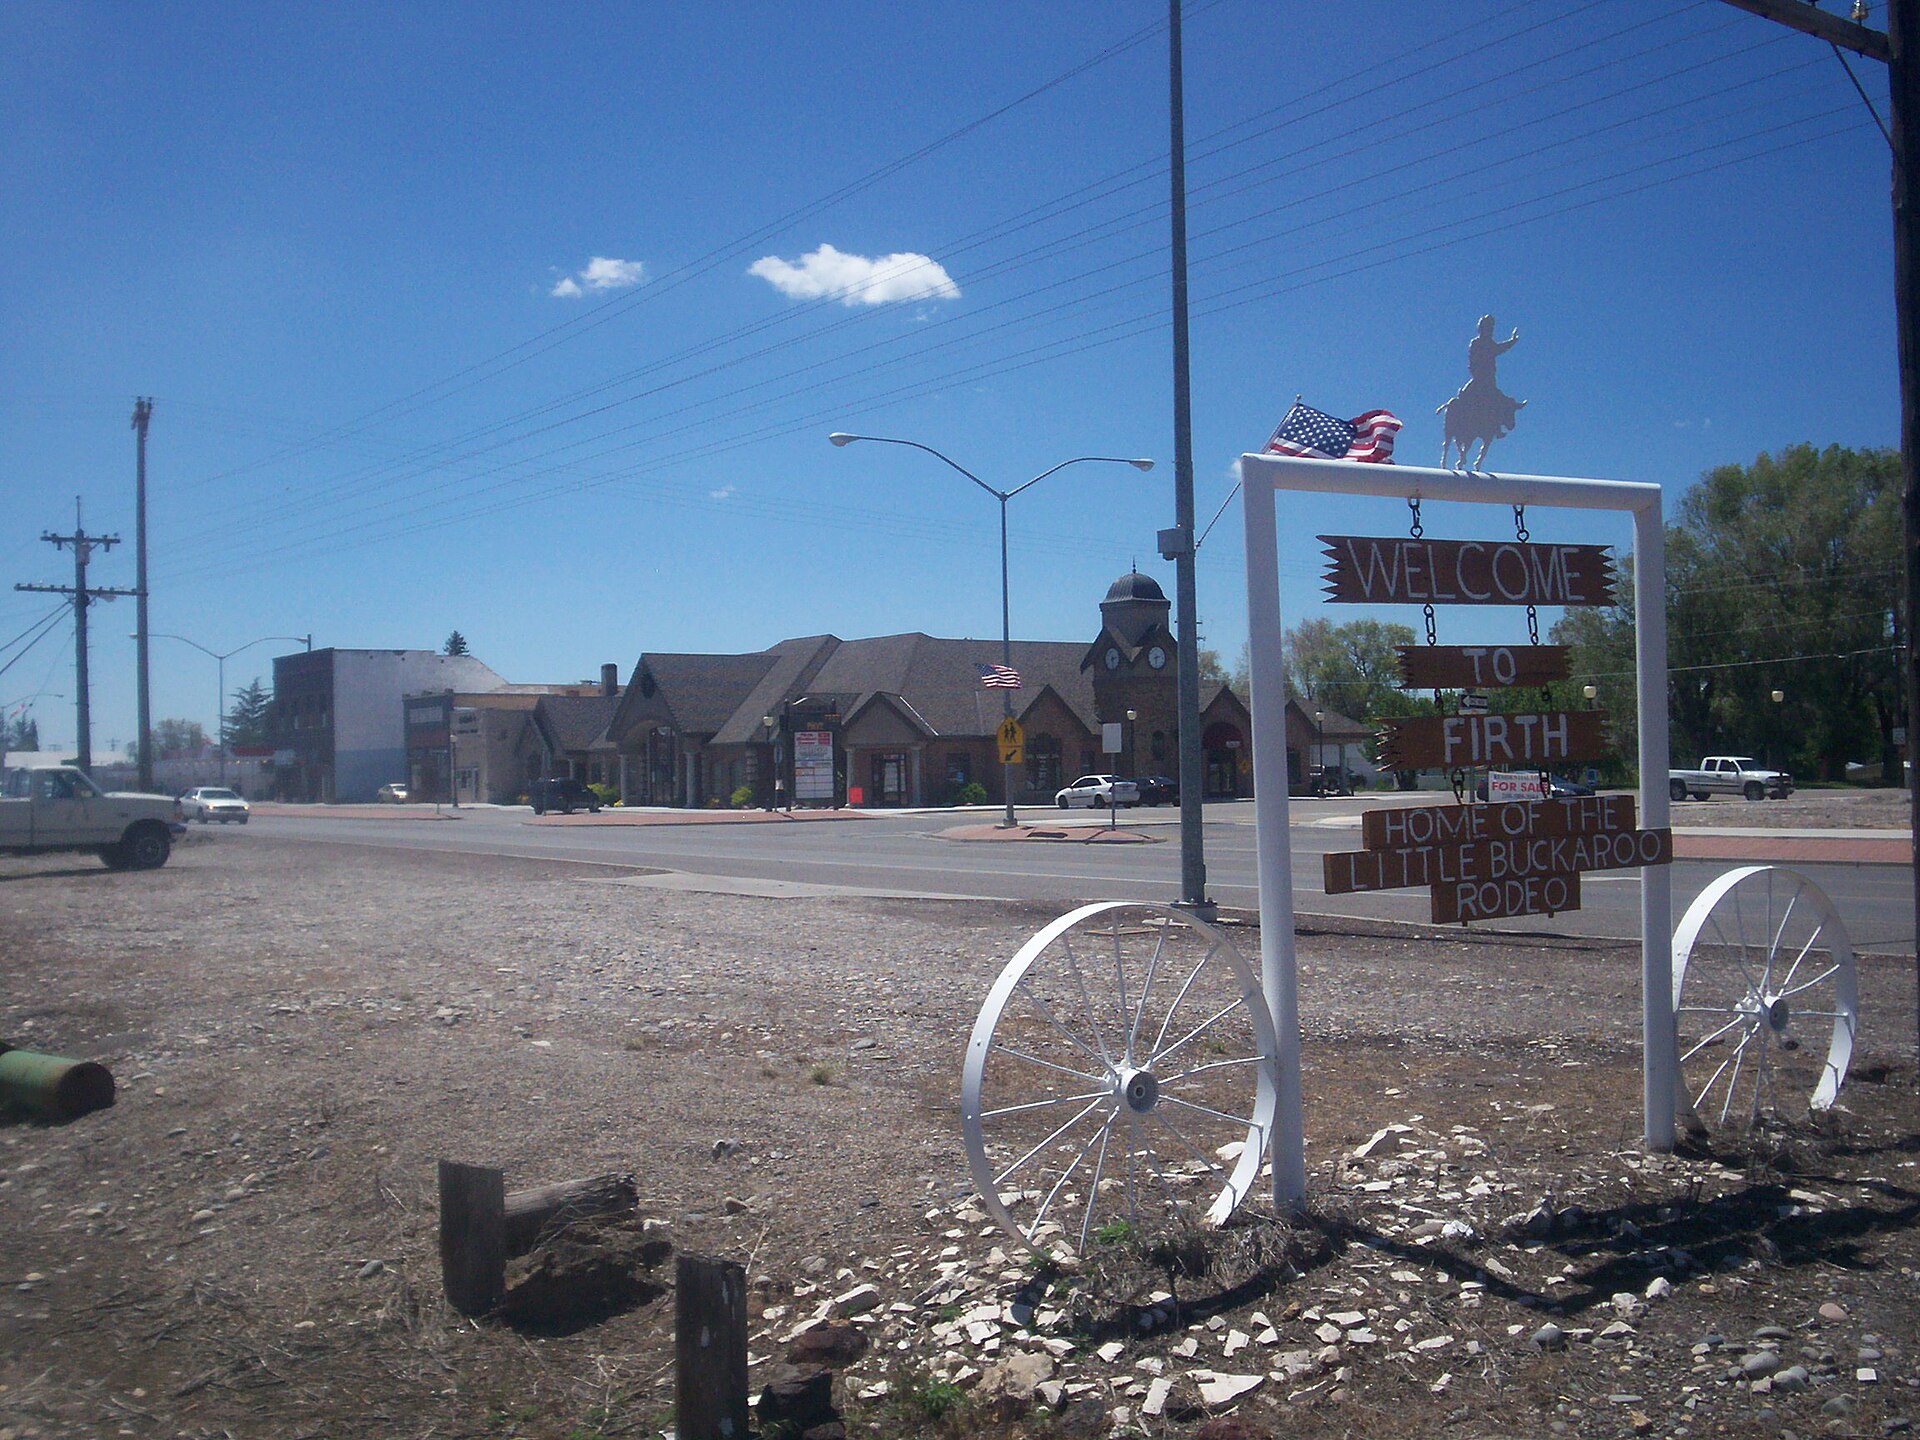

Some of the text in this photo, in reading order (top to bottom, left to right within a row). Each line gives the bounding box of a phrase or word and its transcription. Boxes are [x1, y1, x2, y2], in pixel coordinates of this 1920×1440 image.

[1347, 539, 1585, 601] WELCOME
[1462, 648, 1517, 685] TO
[1443, 713, 1568, 763] FIRTH
[1491, 782, 1549, 794] FOR SALE
[1385, 796, 1619, 844] HOME OF THE
[1350, 830, 1661, 890] LITTLE BUCKAROO
[1457, 877, 1568, 919] RODEO
